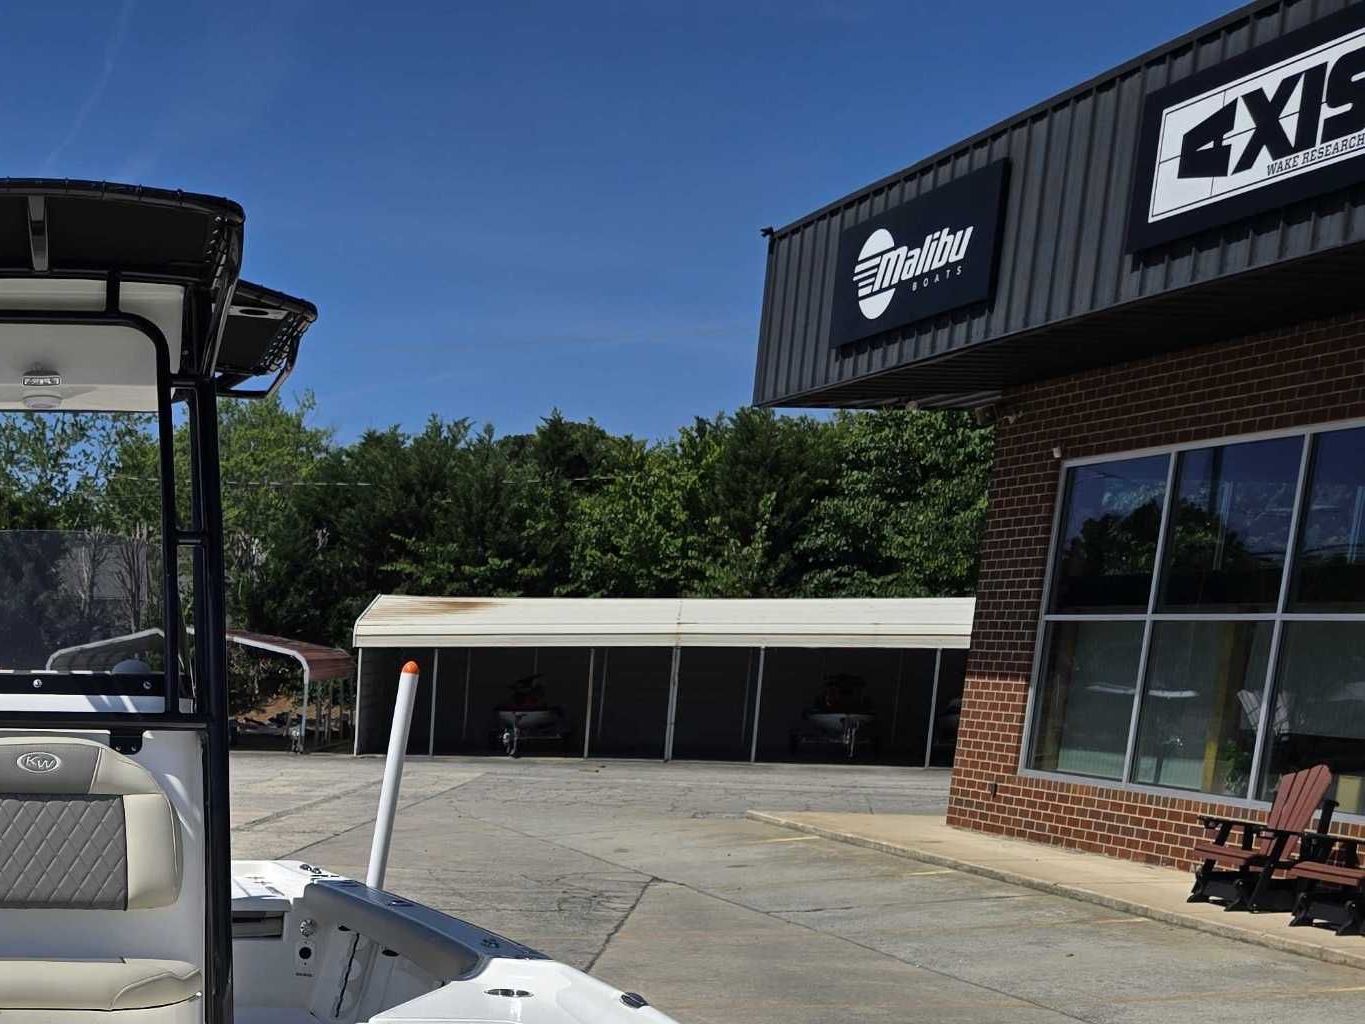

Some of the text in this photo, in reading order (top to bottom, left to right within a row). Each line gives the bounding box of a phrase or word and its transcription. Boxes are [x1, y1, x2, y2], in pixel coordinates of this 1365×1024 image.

[1177, 46, 1365, 179] AXIS
[1266, 155, 1300, 177] WAKE
[872, 226, 974, 293] Malibu
[912, 265, 962, 292] BOATS
